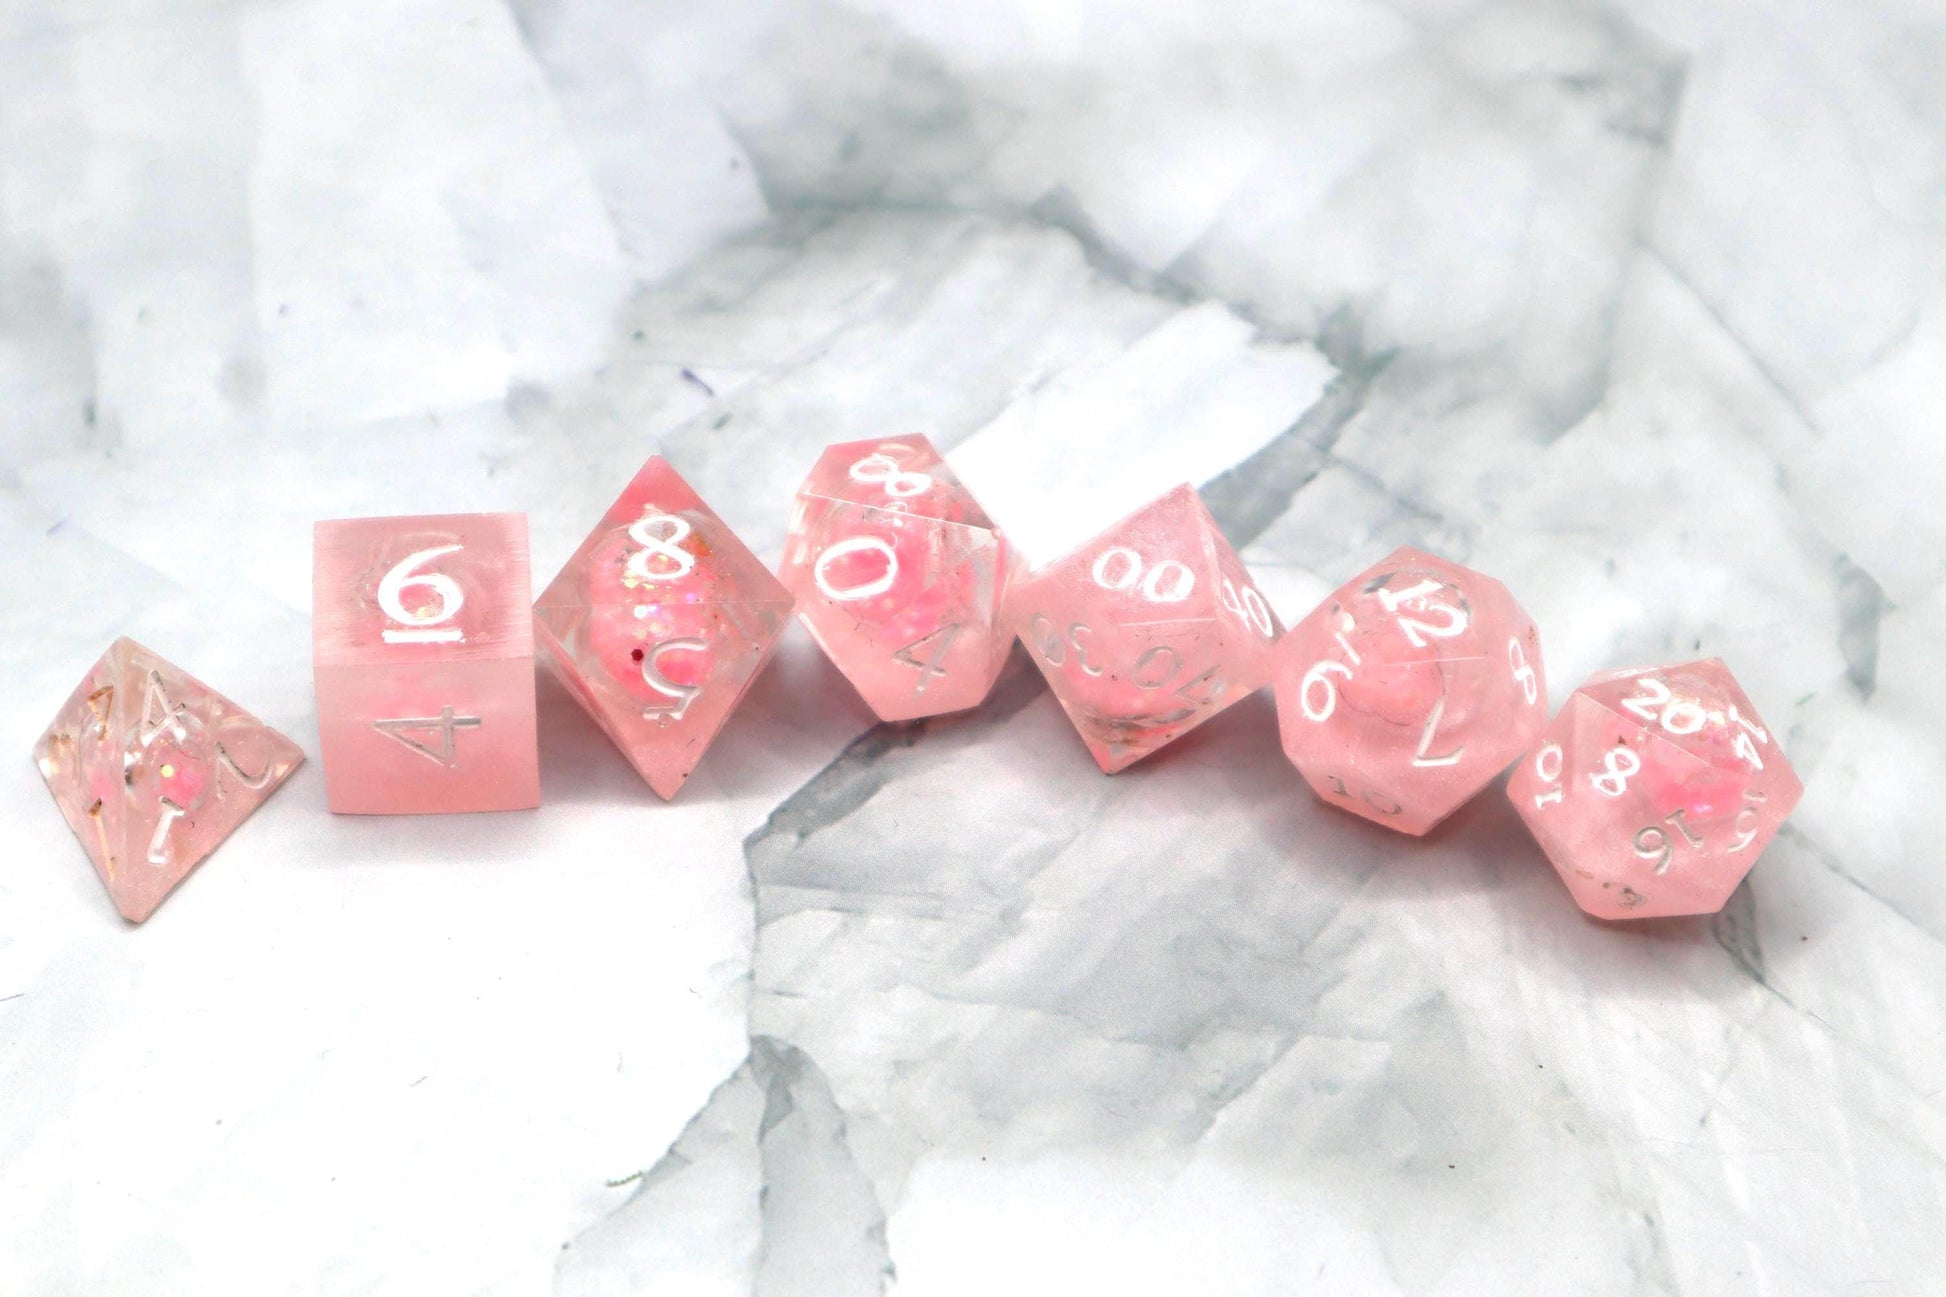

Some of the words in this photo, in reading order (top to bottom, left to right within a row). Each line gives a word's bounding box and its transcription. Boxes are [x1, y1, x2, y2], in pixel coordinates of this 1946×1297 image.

[850, 453, 932, 496] 8
[629, 516, 695, 580] 8
[815, 536, 898, 600] 0
[1092, 549, 1195, 602] 00
[377, 544, 466, 644] 6
[1377, 579, 1469, 648] 12
[893, 622, 964, 698] 4
[372, 704, 483, 768] 4
[1622, 678, 1706, 734] 20
[1535, 742, 1564, 812] 10
[1589, 744, 1641, 797] 8
[144, 795, 187, 865] 1
[1632, 808, 1704, 878] 16
